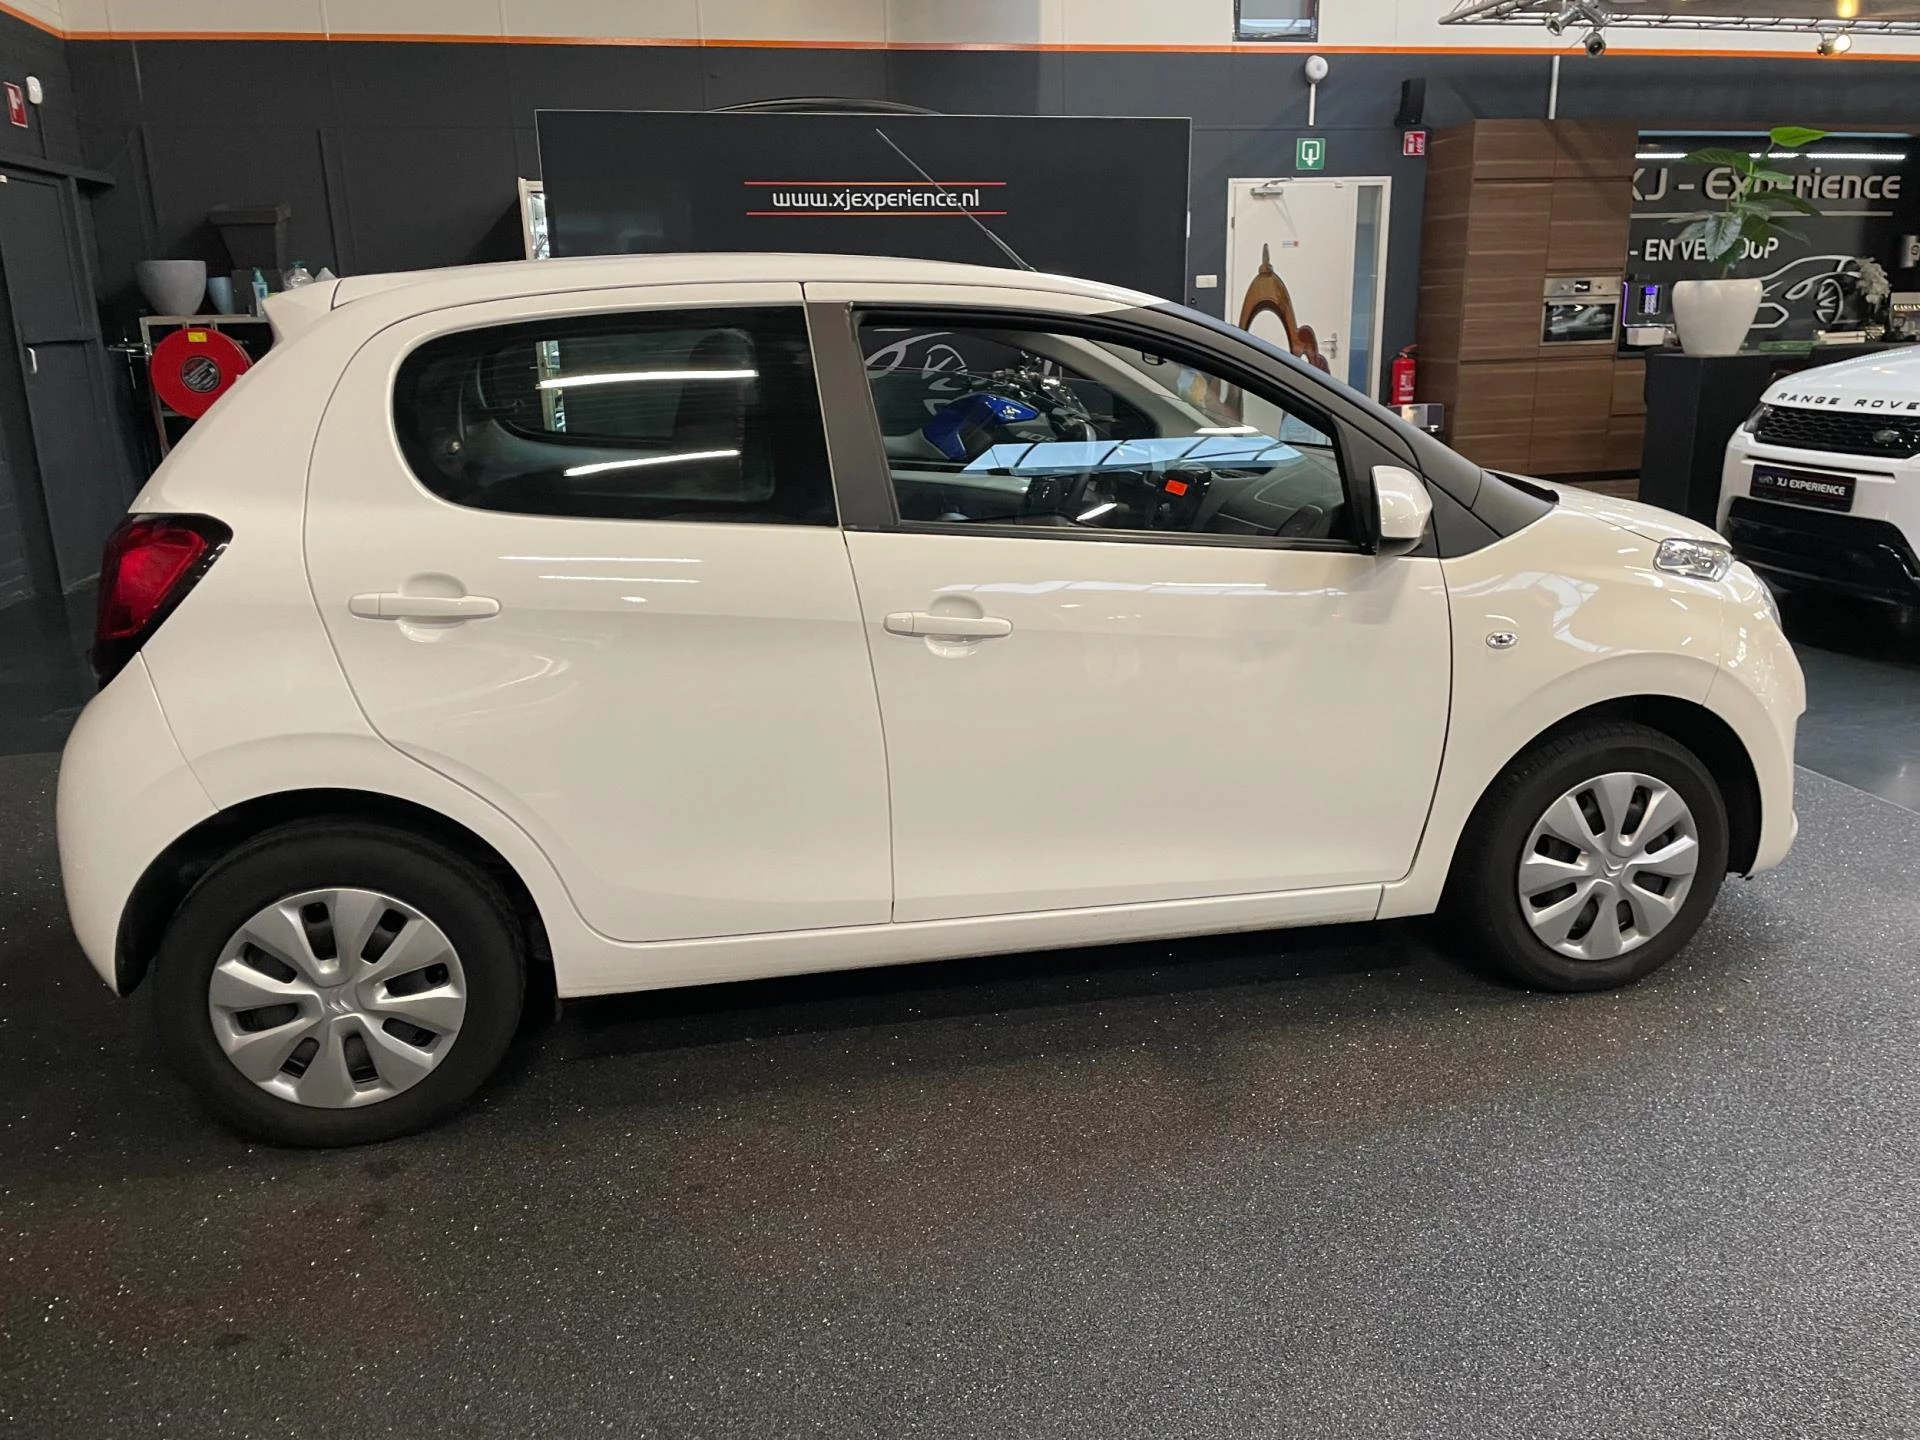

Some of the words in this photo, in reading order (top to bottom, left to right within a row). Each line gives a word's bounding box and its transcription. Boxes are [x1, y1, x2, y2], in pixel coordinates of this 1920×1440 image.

[772, 189, 979, 211] www.xjexperience.nl
[1644, 239, 1675, 261] EN
[1777, 392, 1841, 405] RANGE
[1854, 398, 1920, 410] ROVE
[1776, 476, 1788, 487] XJ
[1788, 479, 1846, 496] EXPERIENCE
